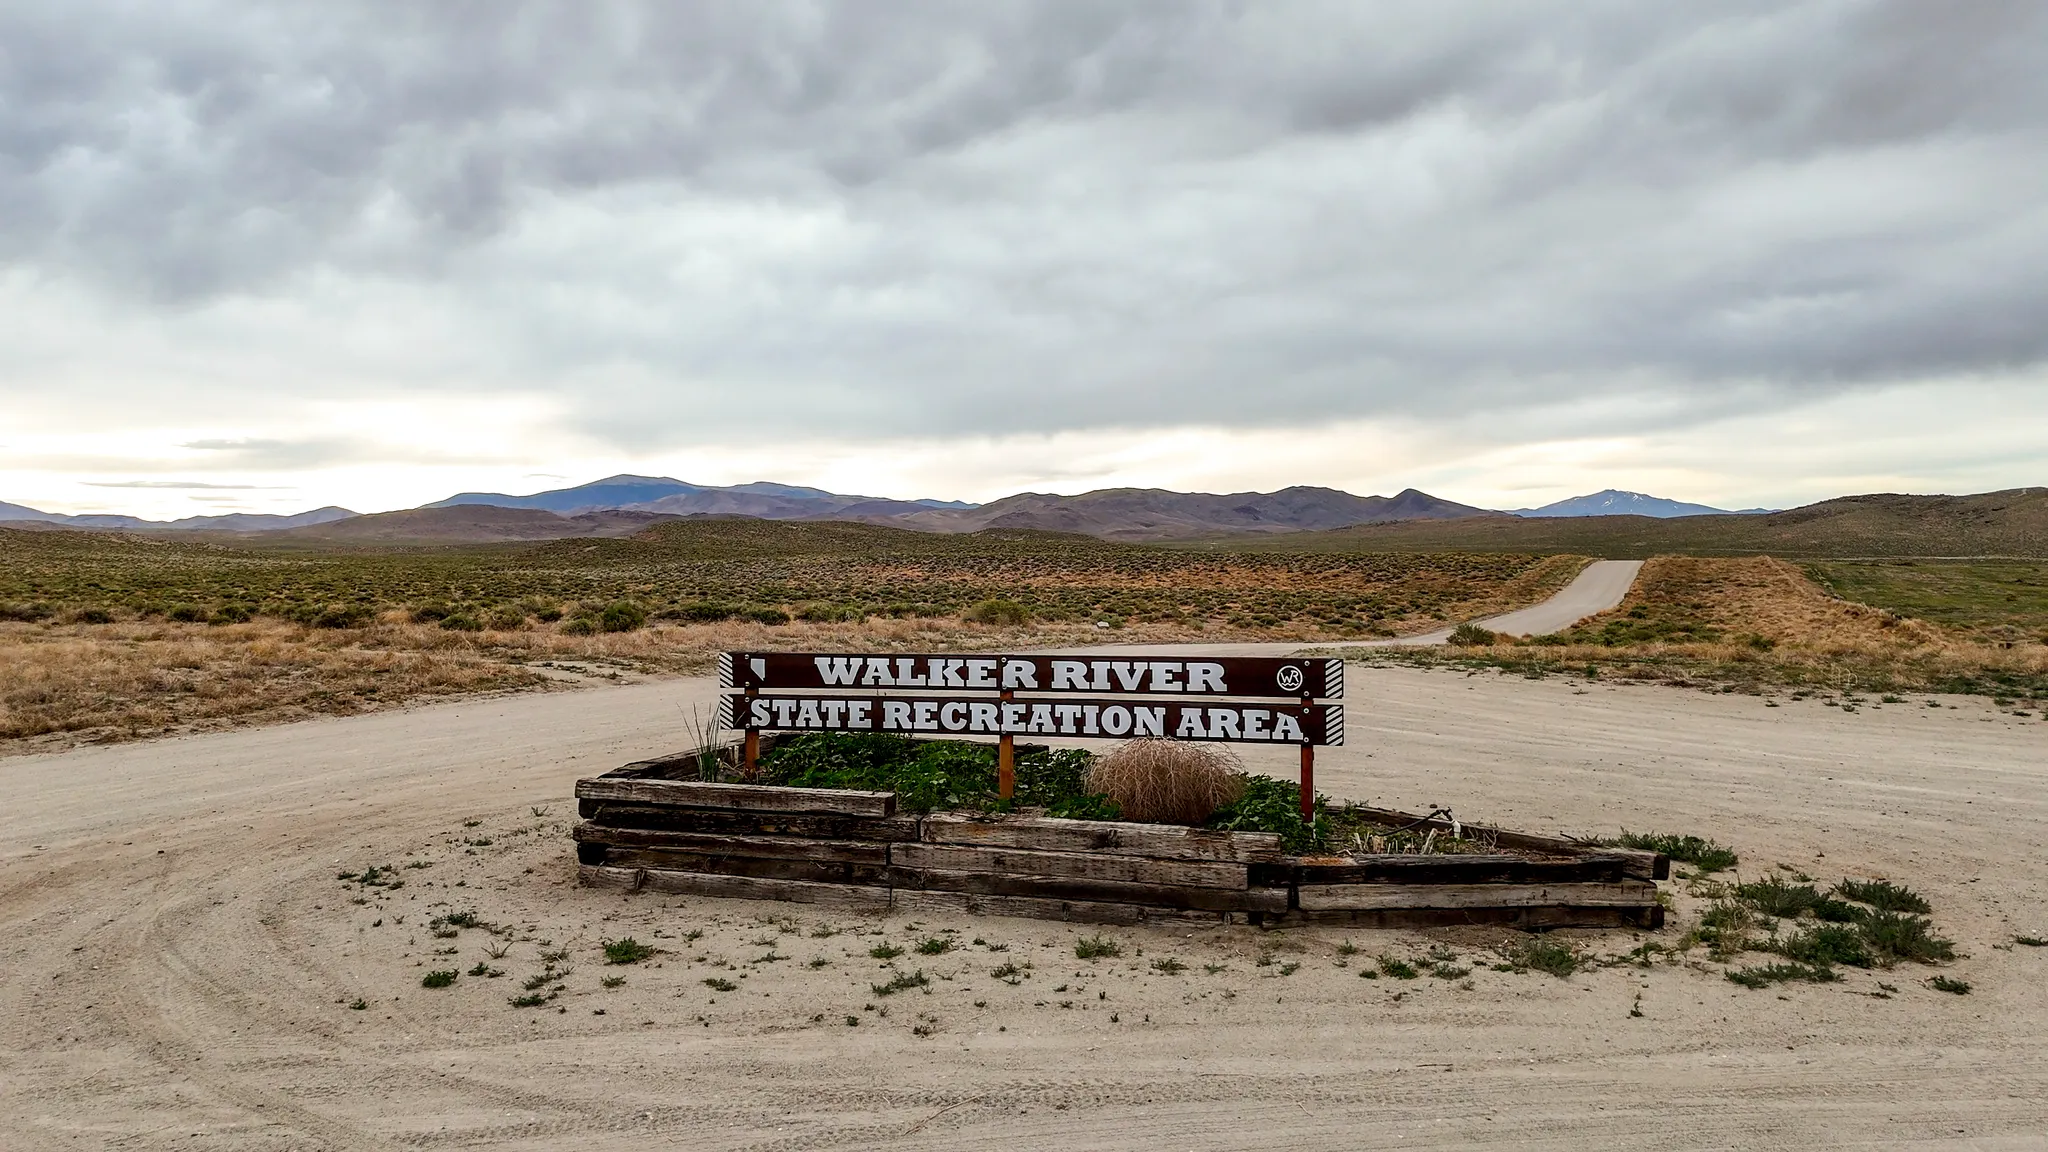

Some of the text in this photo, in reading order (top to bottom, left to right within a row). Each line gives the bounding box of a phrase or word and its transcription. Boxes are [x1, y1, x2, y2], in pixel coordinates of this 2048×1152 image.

[814, 657, 1227, 692] WALKER RIVER
[750, 699, 1303, 740] STATE RECREATION AREA
